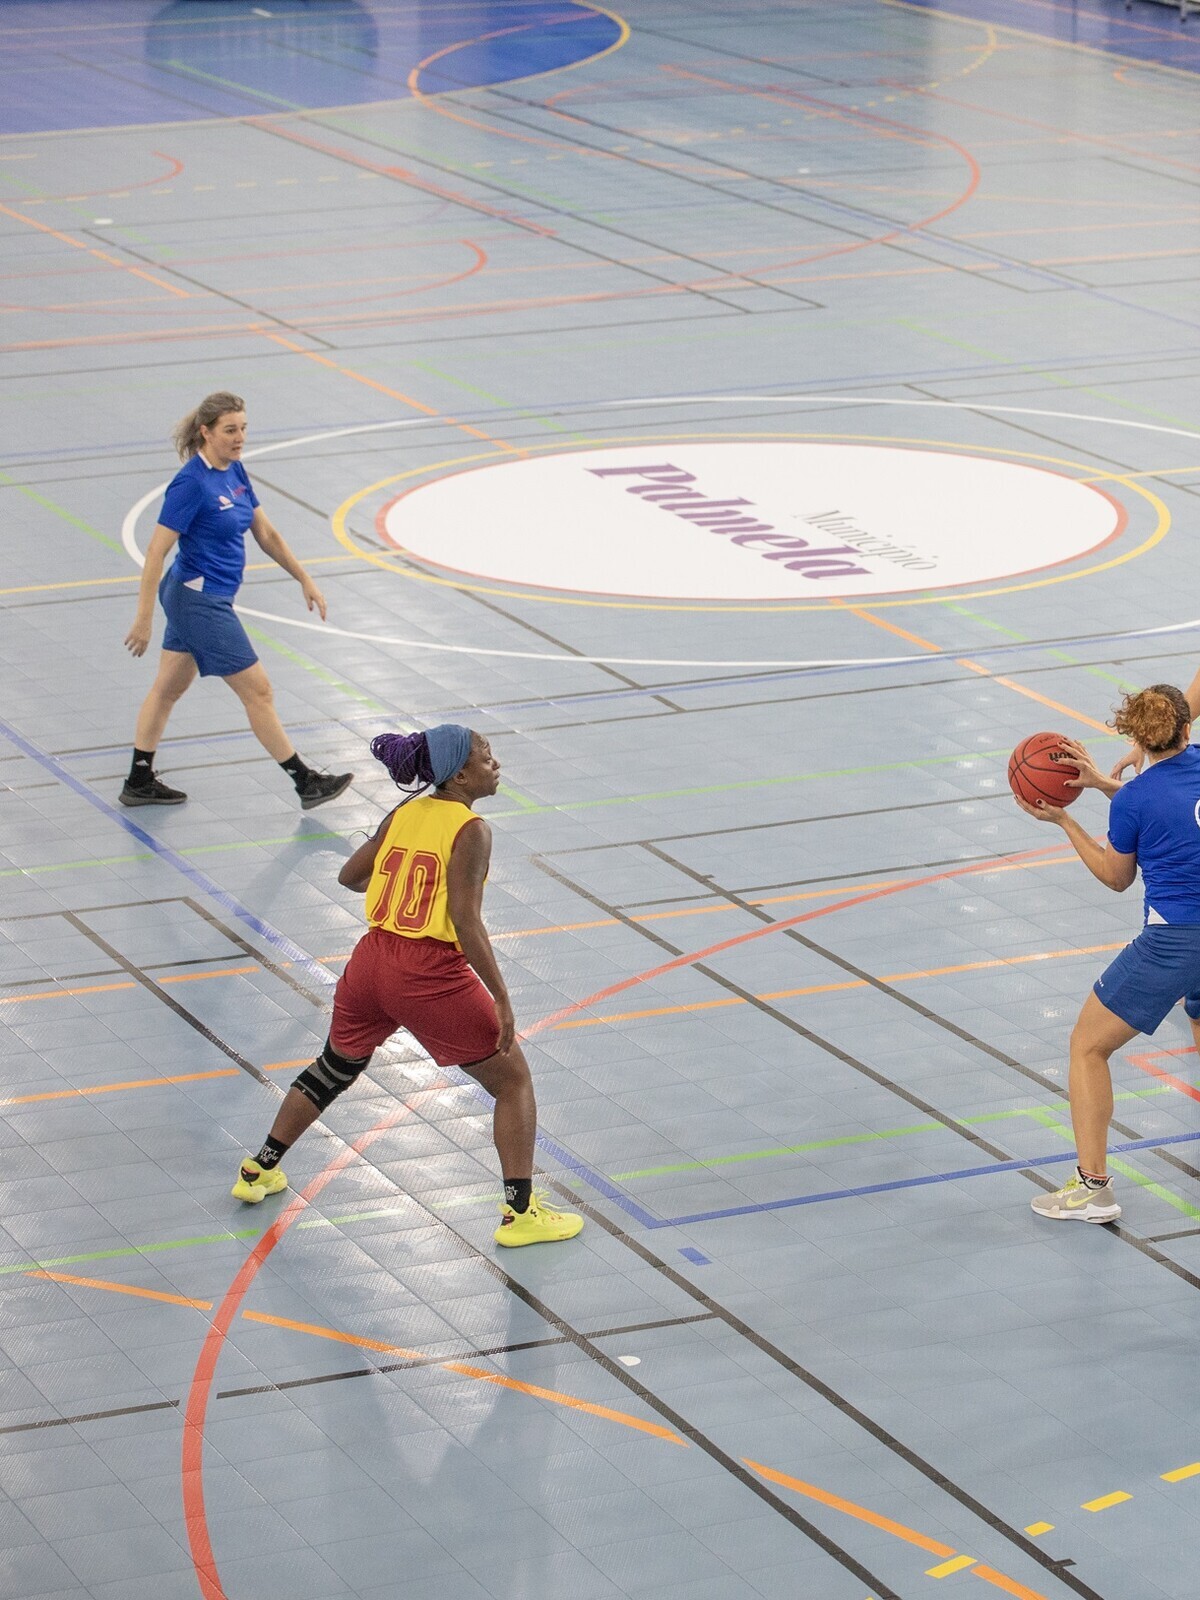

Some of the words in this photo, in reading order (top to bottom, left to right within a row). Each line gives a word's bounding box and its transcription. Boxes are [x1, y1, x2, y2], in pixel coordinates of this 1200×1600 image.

[583, 462, 874, 581] Palmela
[791, 509, 940, 571] Município
[371, 846, 441, 932] 10
